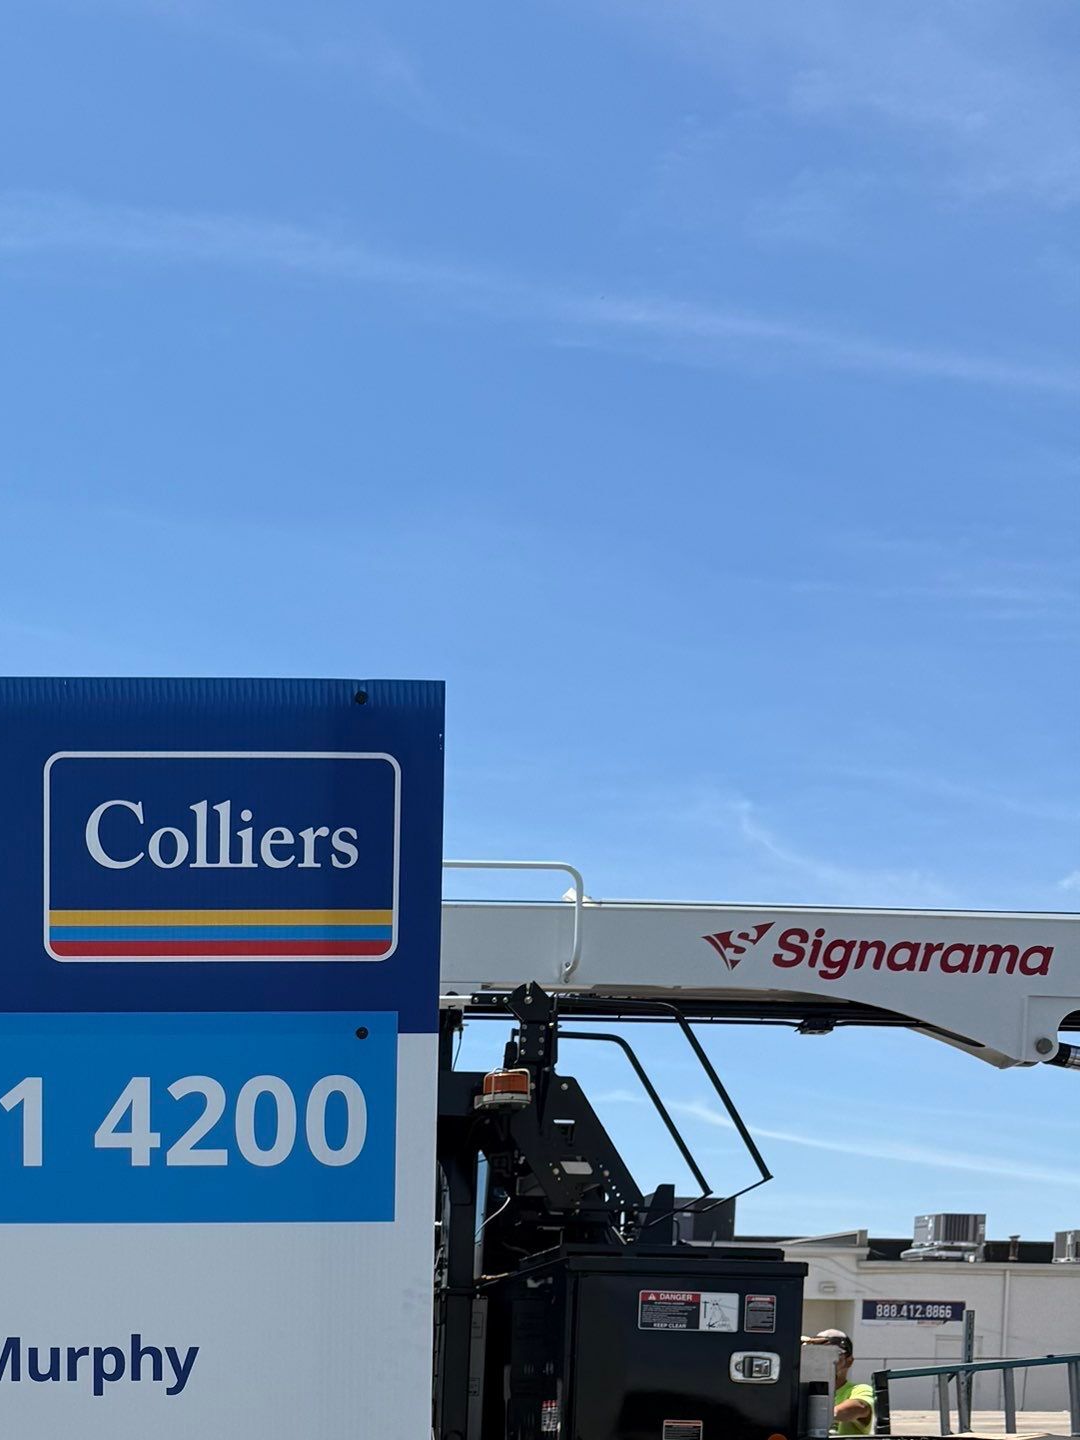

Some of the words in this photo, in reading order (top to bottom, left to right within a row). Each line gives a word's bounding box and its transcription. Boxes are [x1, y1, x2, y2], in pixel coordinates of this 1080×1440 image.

[85, 799, 359, 870] Colliers
[772, 927, 1054, 980] Signarama
[94, 1074, 368, 1168] 4200
[659, 1293, 693, 1301] DANGER
